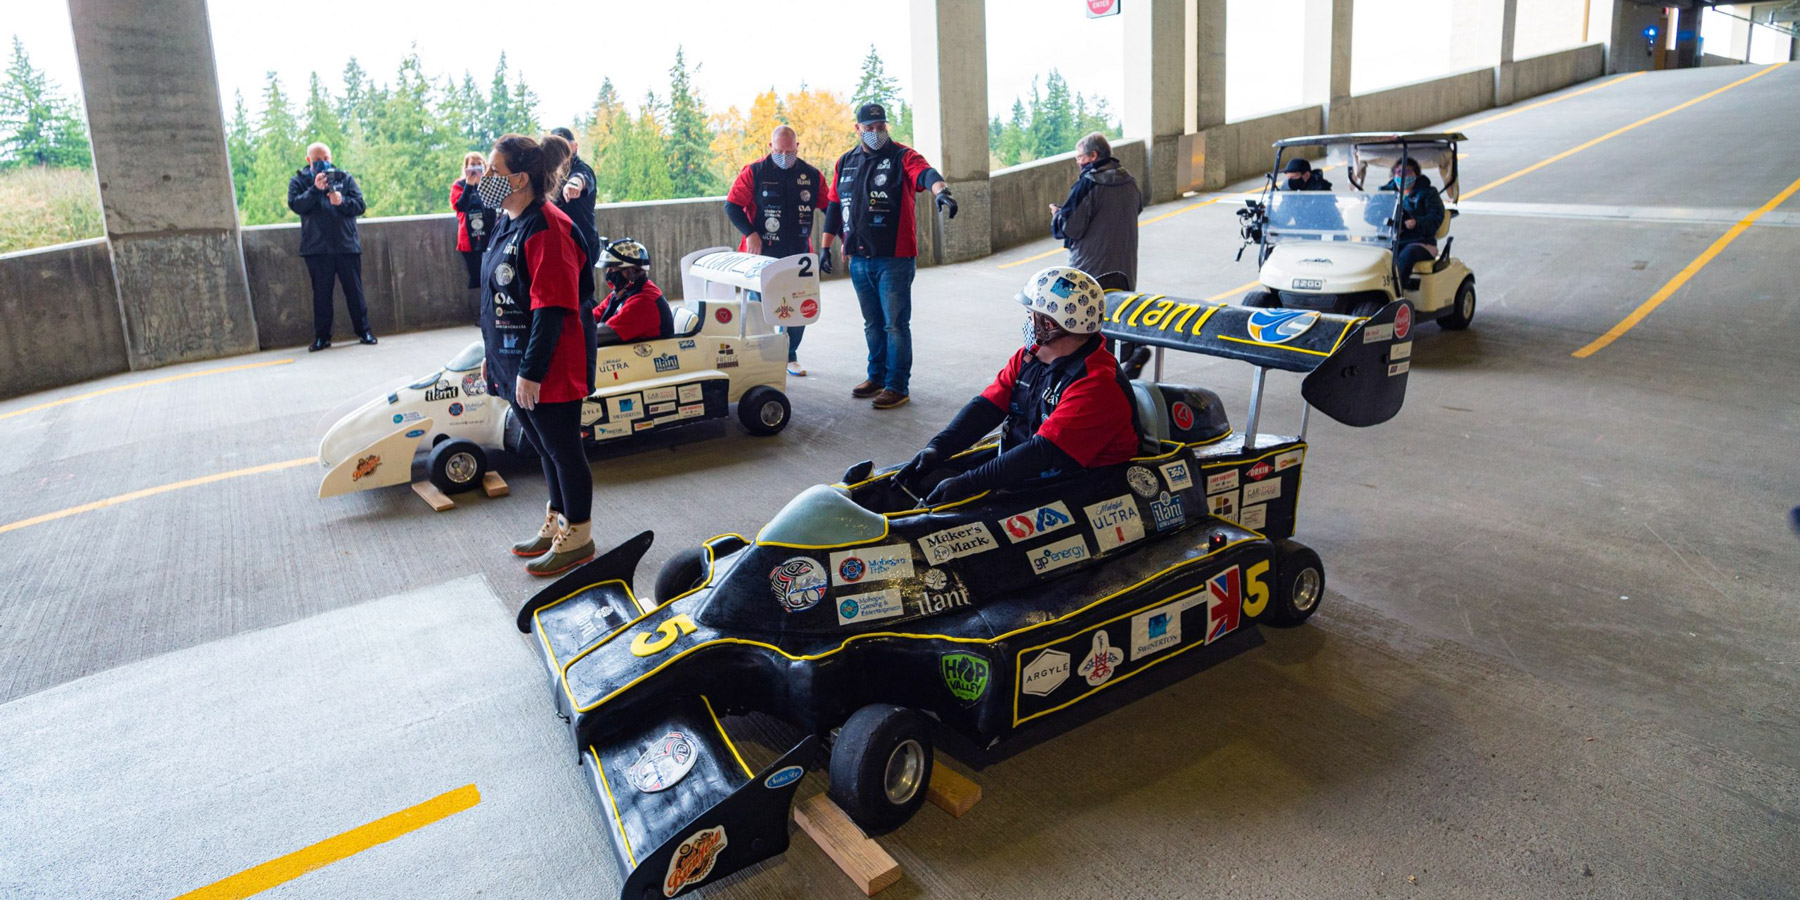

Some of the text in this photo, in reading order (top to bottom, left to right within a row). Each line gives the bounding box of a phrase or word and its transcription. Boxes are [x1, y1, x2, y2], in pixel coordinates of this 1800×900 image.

[798, 256, 813, 277] 2
[1112, 292, 1228, 336] ilani
[599, 361, 629, 373] ULTRA
[427, 387, 458, 401] ilani
[1167, 466, 1186, 478] 360
[1250, 465, 1269, 476] ORKIN
[1093, 506, 1137, 529] ULTRA
[1154, 499, 1183, 522] ilani
[927, 526, 982, 548] Maker's
[1242, 559, 1270, 617] 5
[917, 585, 972, 616] ilani
[630, 613, 698, 657] 5
[1137, 634, 1178, 654] SWINERTON
[1026, 662, 1069, 683] ARGYLE
[949, 680, 981, 695] VALLEY
